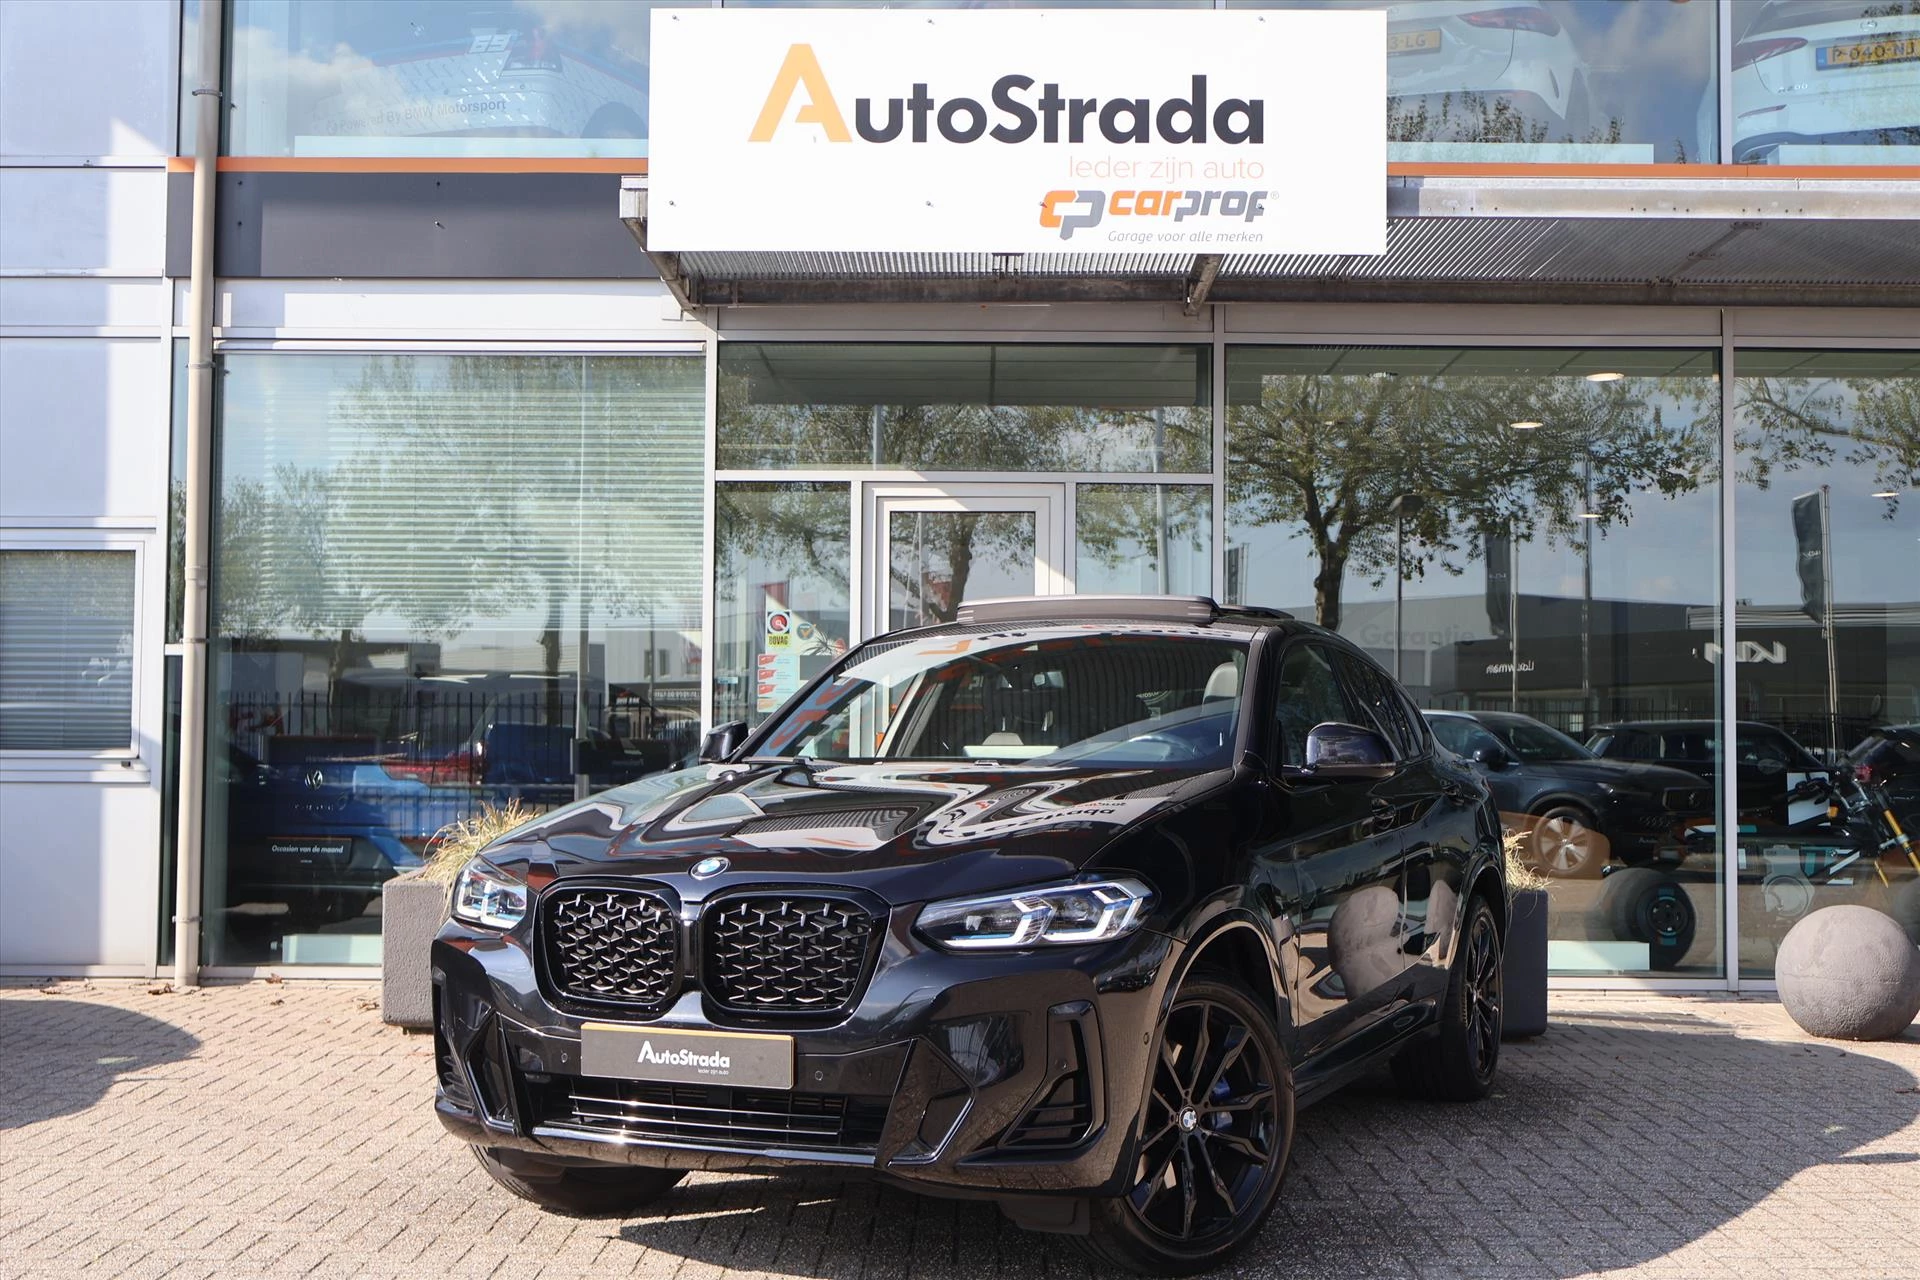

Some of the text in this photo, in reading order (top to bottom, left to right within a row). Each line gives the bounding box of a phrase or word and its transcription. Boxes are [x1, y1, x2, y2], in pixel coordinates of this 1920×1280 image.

[1389, 34, 1426, 50] 3-LG
[748, 43, 1264, 144] AutoStrada
[386, 111, 401, 125] By
[405, 106, 434, 120] BMW
[437, 99, 506, 115] Motorsport
[1149, 156, 1194, 184] zijn
[1203, 158, 1265, 179] auto
[1108, 231, 1263, 245] Garage voor alle merken
[1360, 623, 1475, 646] Garantie
[271, 844, 298, 853] Occasion
[321, 845, 344, 854] maand
[637, 1040, 730, 1068] AutoStrada
